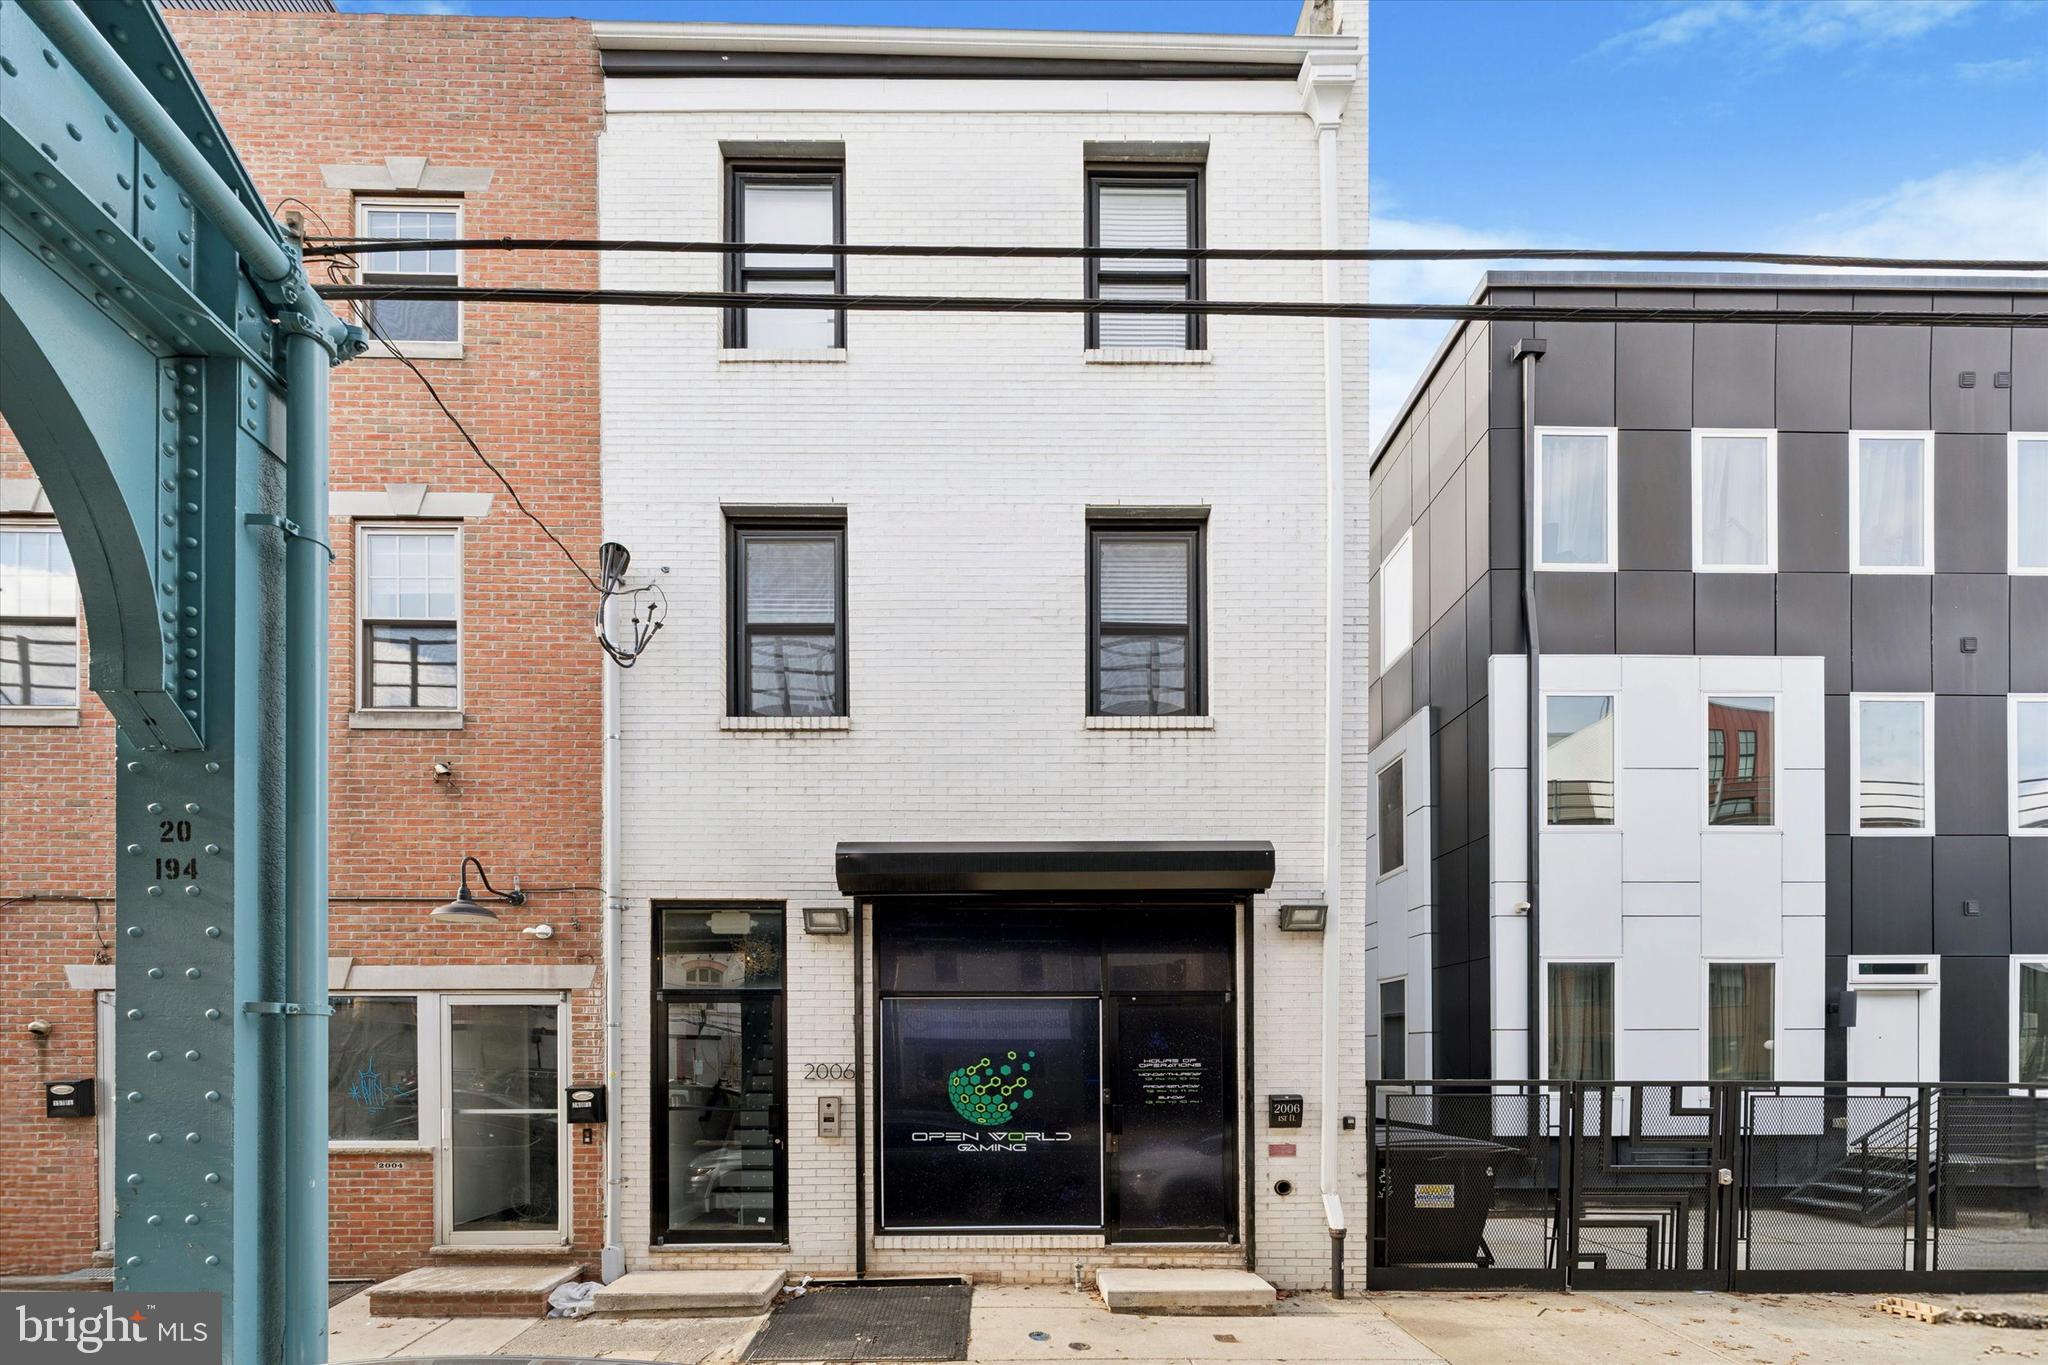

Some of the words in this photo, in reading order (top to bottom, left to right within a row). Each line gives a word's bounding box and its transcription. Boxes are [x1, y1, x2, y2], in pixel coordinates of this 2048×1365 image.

[160, 820, 192, 842] 20
[156, 858, 198, 880] 194
[804, 1063, 856, 1079] 2006
[1274, 1103, 1300, 1113] 2006
[911, 1132, 979, 1141] OPEN
[988, 1132, 1072, 1141] WORLD
[957, 1143, 1027, 1152] GAMING
